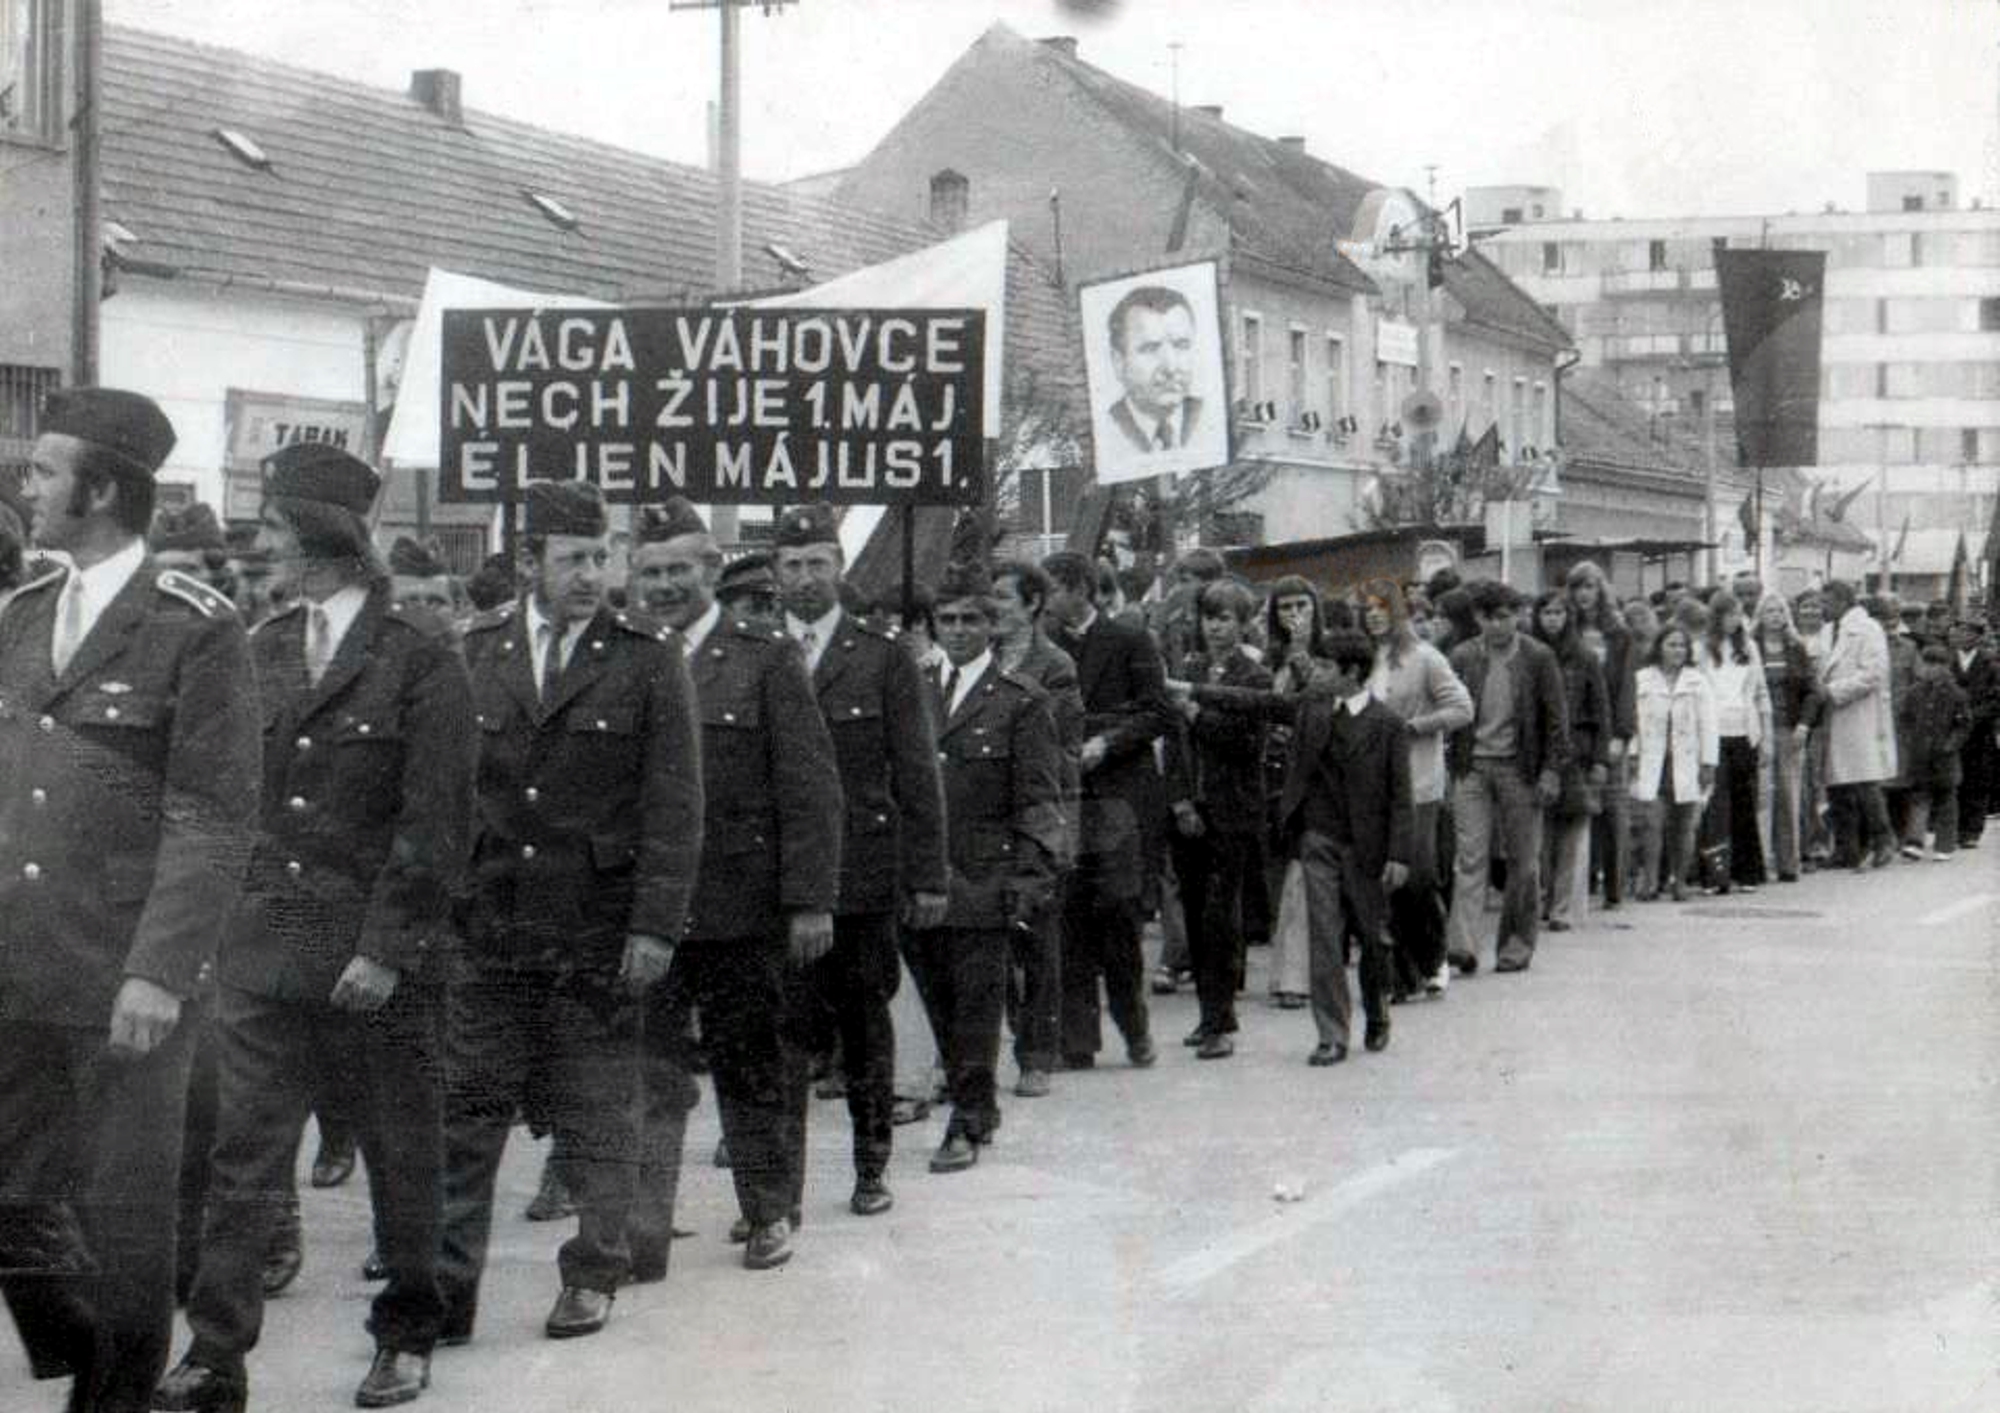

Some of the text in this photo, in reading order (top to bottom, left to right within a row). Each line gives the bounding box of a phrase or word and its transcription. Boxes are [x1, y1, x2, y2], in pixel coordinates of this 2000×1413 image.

[484, 308, 965, 372] VÁGA VÁHOVCE
[451, 380, 629, 433] NECH
[656, 369, 790, 429] ŽIJE
[460, 432, 687, 490] ÉLJEN
